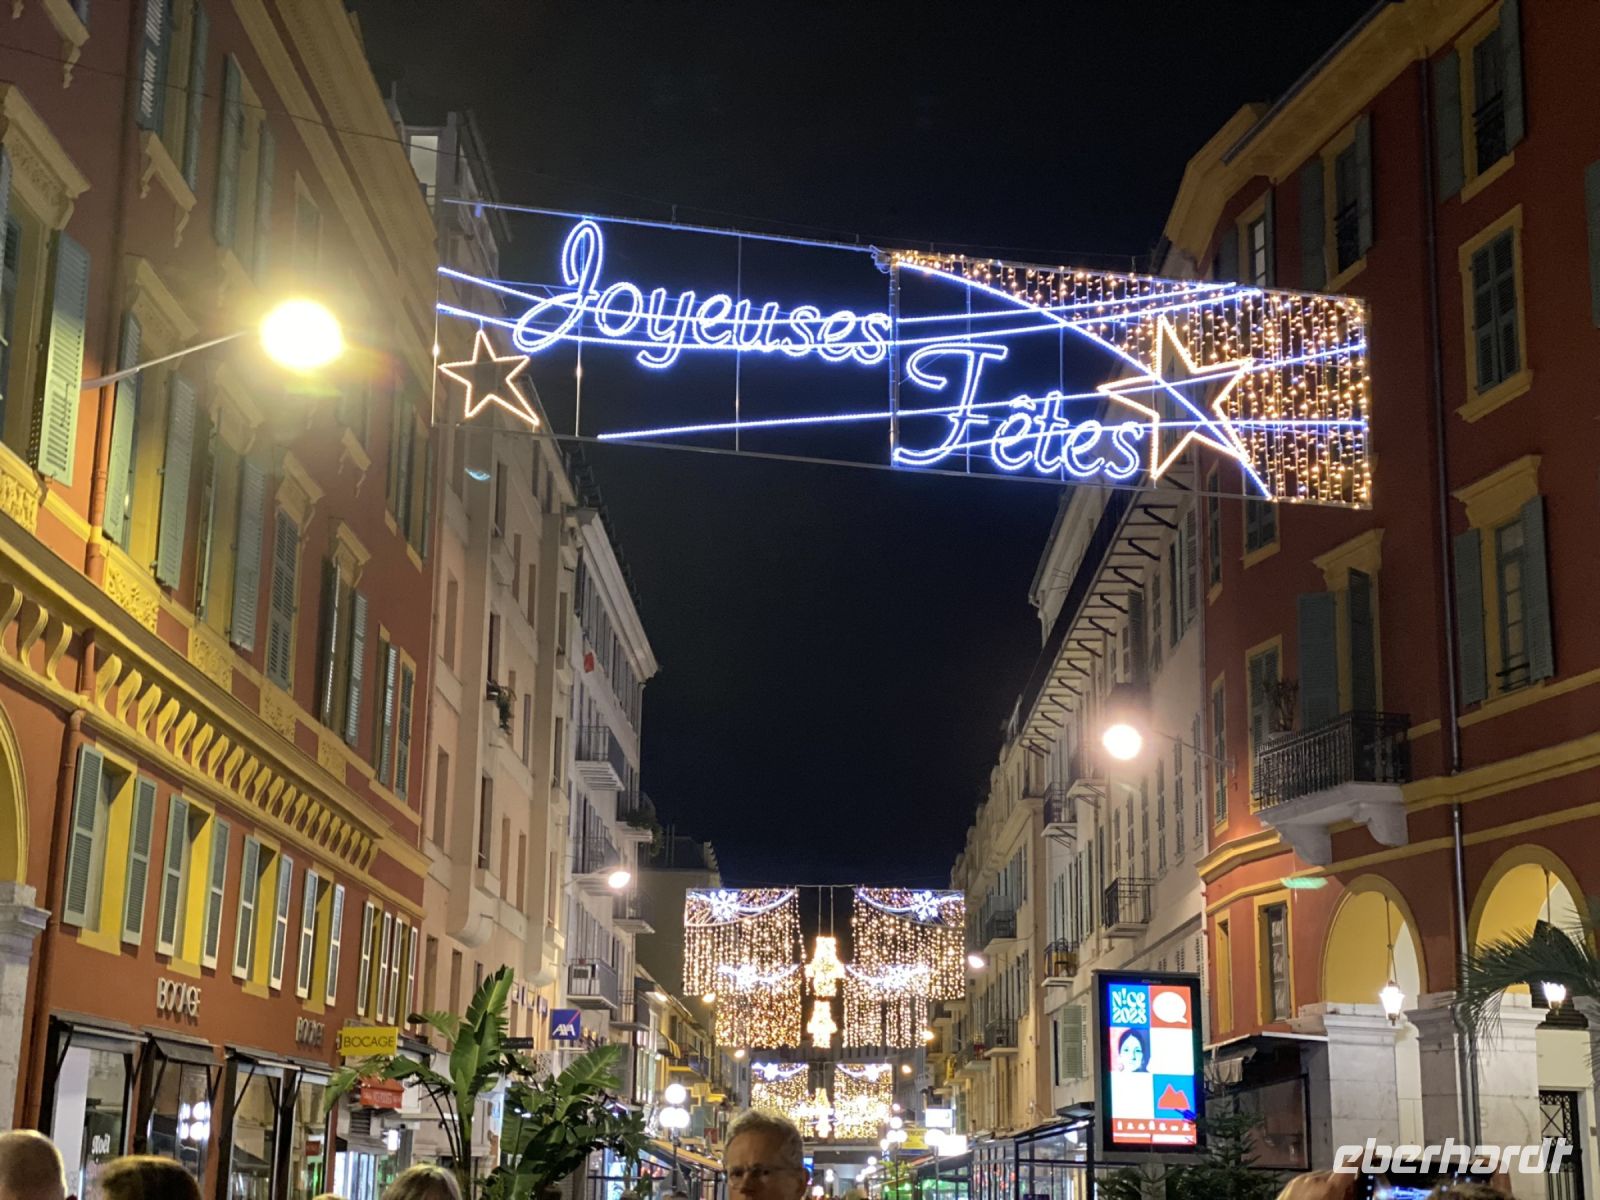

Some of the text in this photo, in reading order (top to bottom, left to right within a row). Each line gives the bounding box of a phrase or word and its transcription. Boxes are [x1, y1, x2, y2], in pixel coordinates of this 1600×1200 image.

[513, 219, 894, 369] Joyeuses
[893, 342, 1145, 478] Fêtes
[1113, 1007, 1147, 1024] 2028
[552, 1023, 576, 1037] AXA
[343, 1036, 395, 1048] BOCAGE
